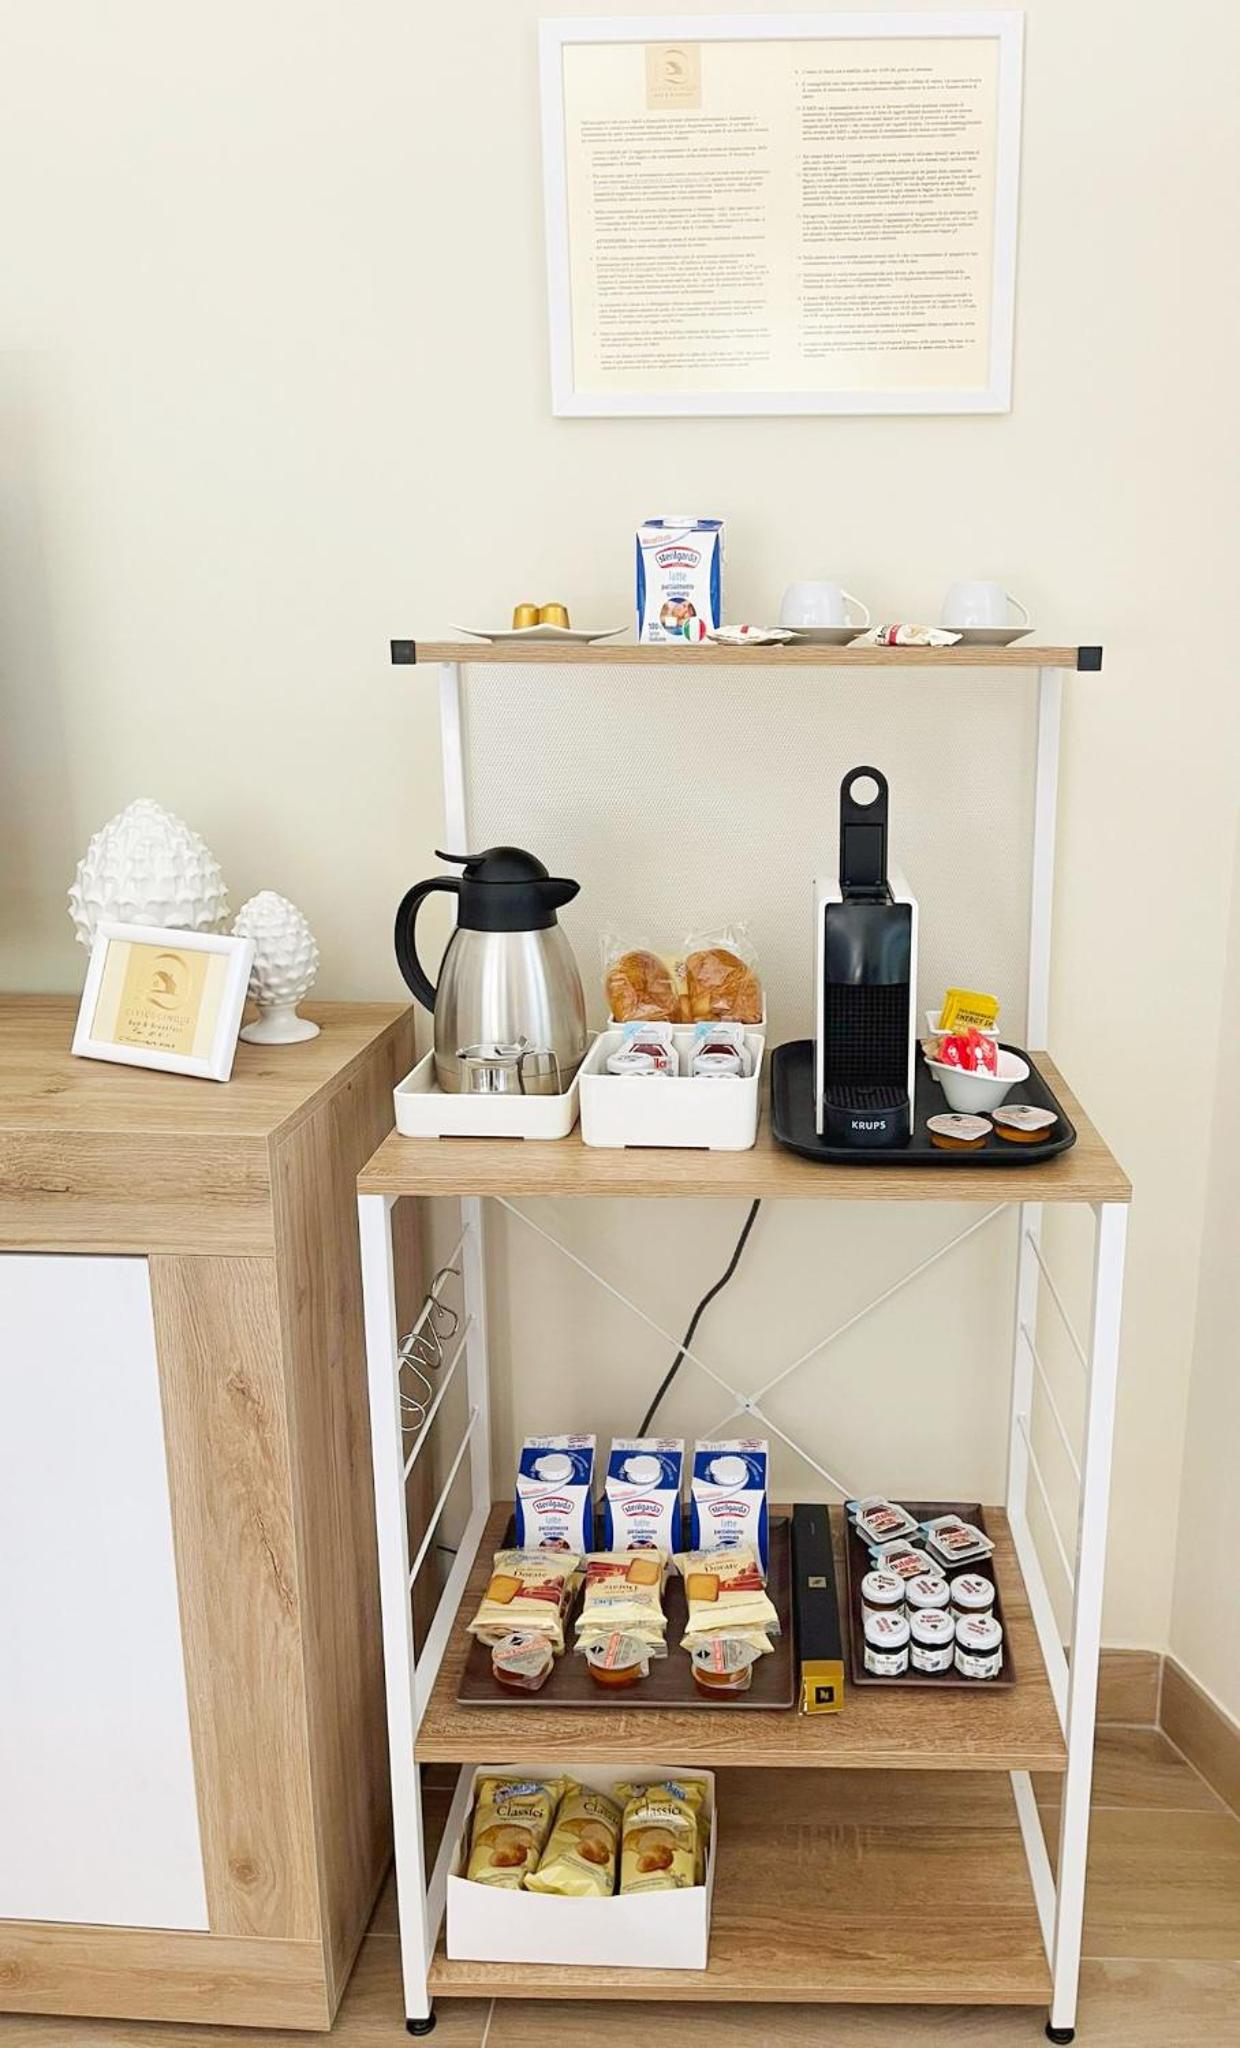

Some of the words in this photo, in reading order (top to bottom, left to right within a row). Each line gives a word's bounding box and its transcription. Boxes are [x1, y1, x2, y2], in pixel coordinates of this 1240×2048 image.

[669, 570, 688, 581] latte
[956, 1013, 984, 1025] ENERGY
[851, 1120, 887, 1130] KRUPS
[496, 1801, 545, 1818] Classici
